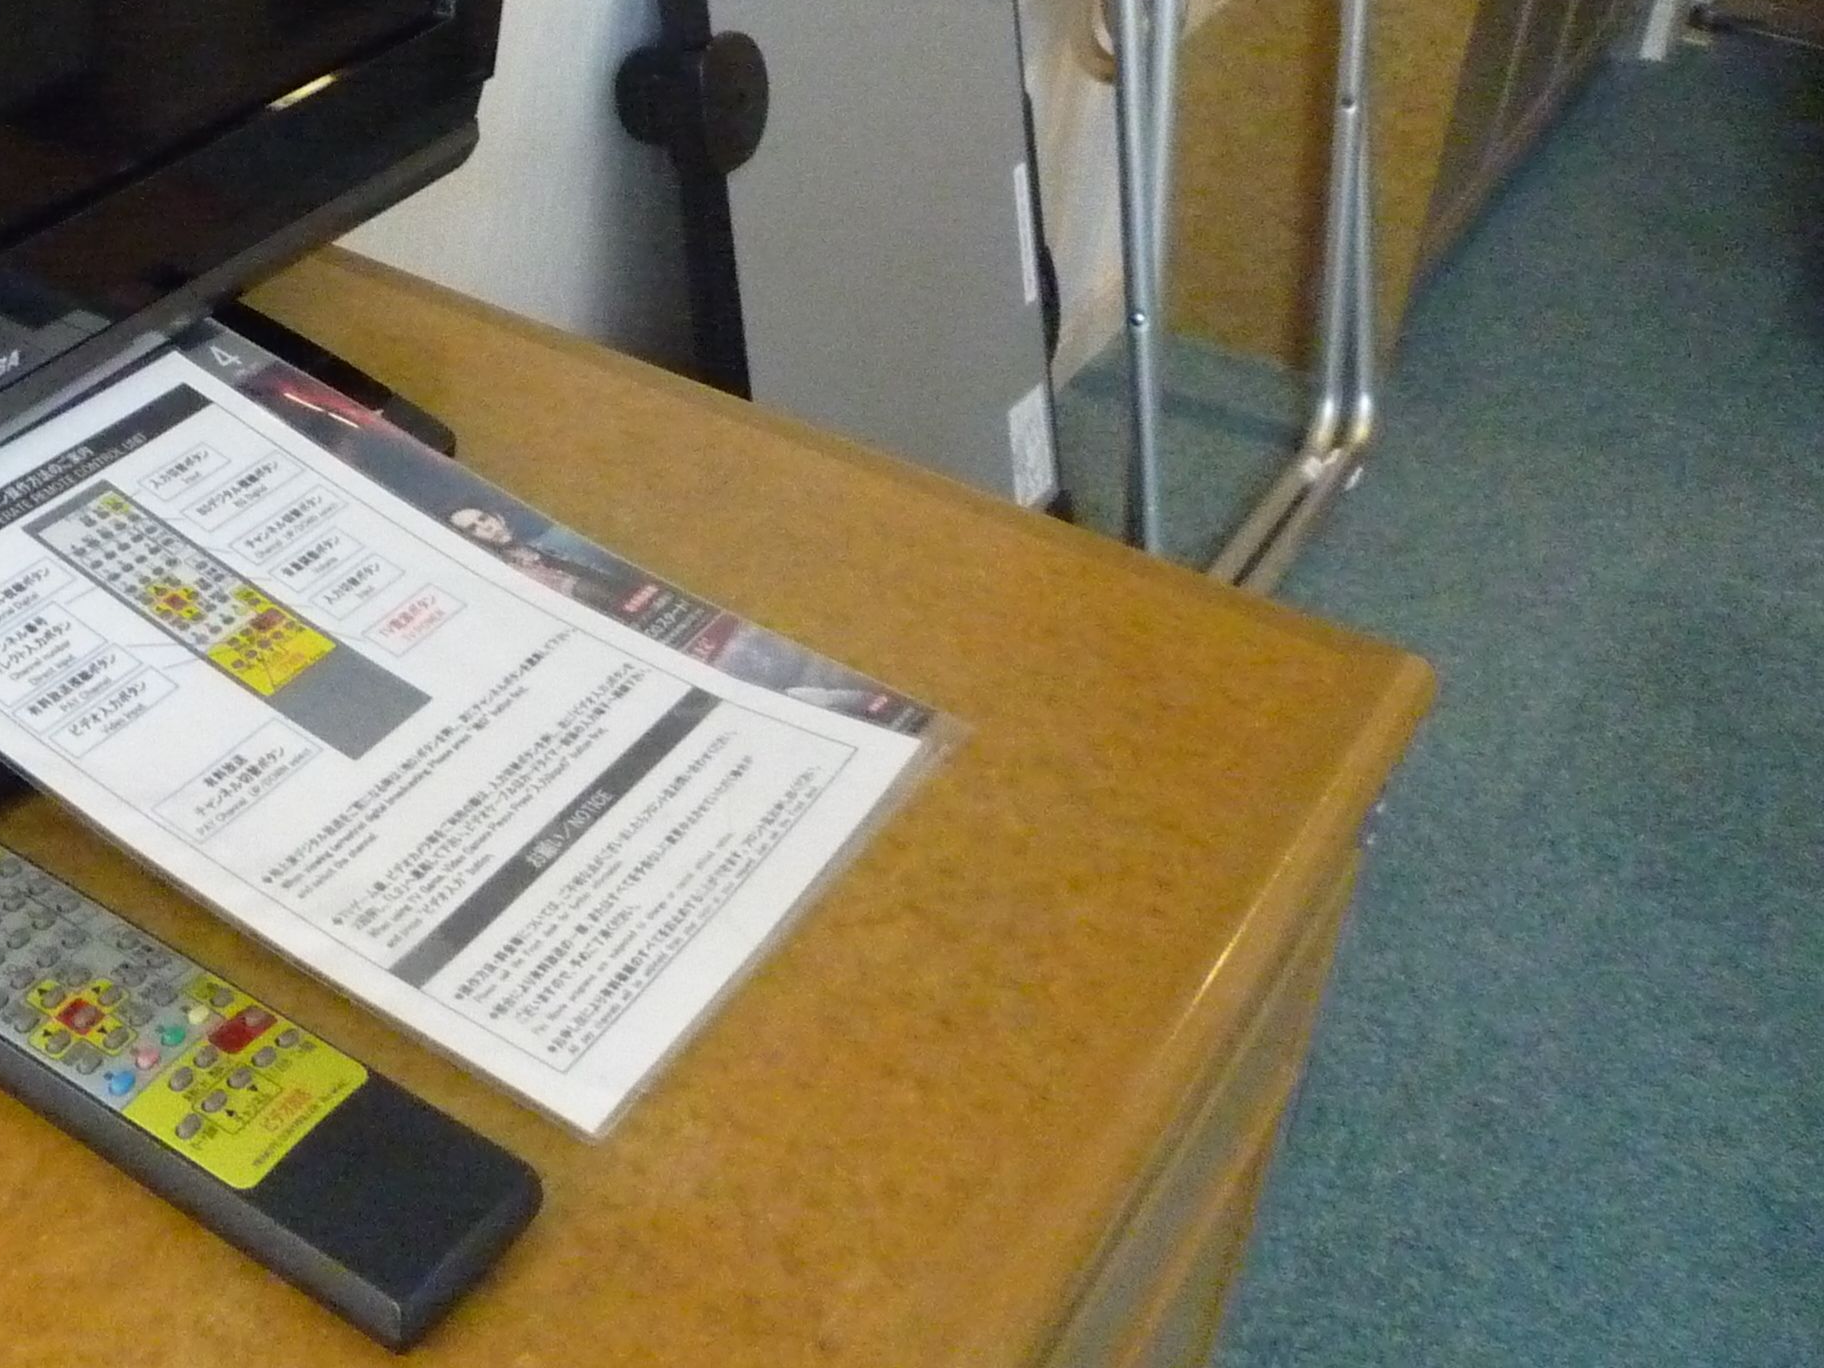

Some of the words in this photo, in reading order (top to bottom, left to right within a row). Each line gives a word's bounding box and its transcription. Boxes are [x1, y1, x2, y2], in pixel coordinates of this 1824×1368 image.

[29, 474, 77, 503] REMOTE
[71, 446, 124, 477] CONTROL
[200, 752, 249, 789] 有料放送
